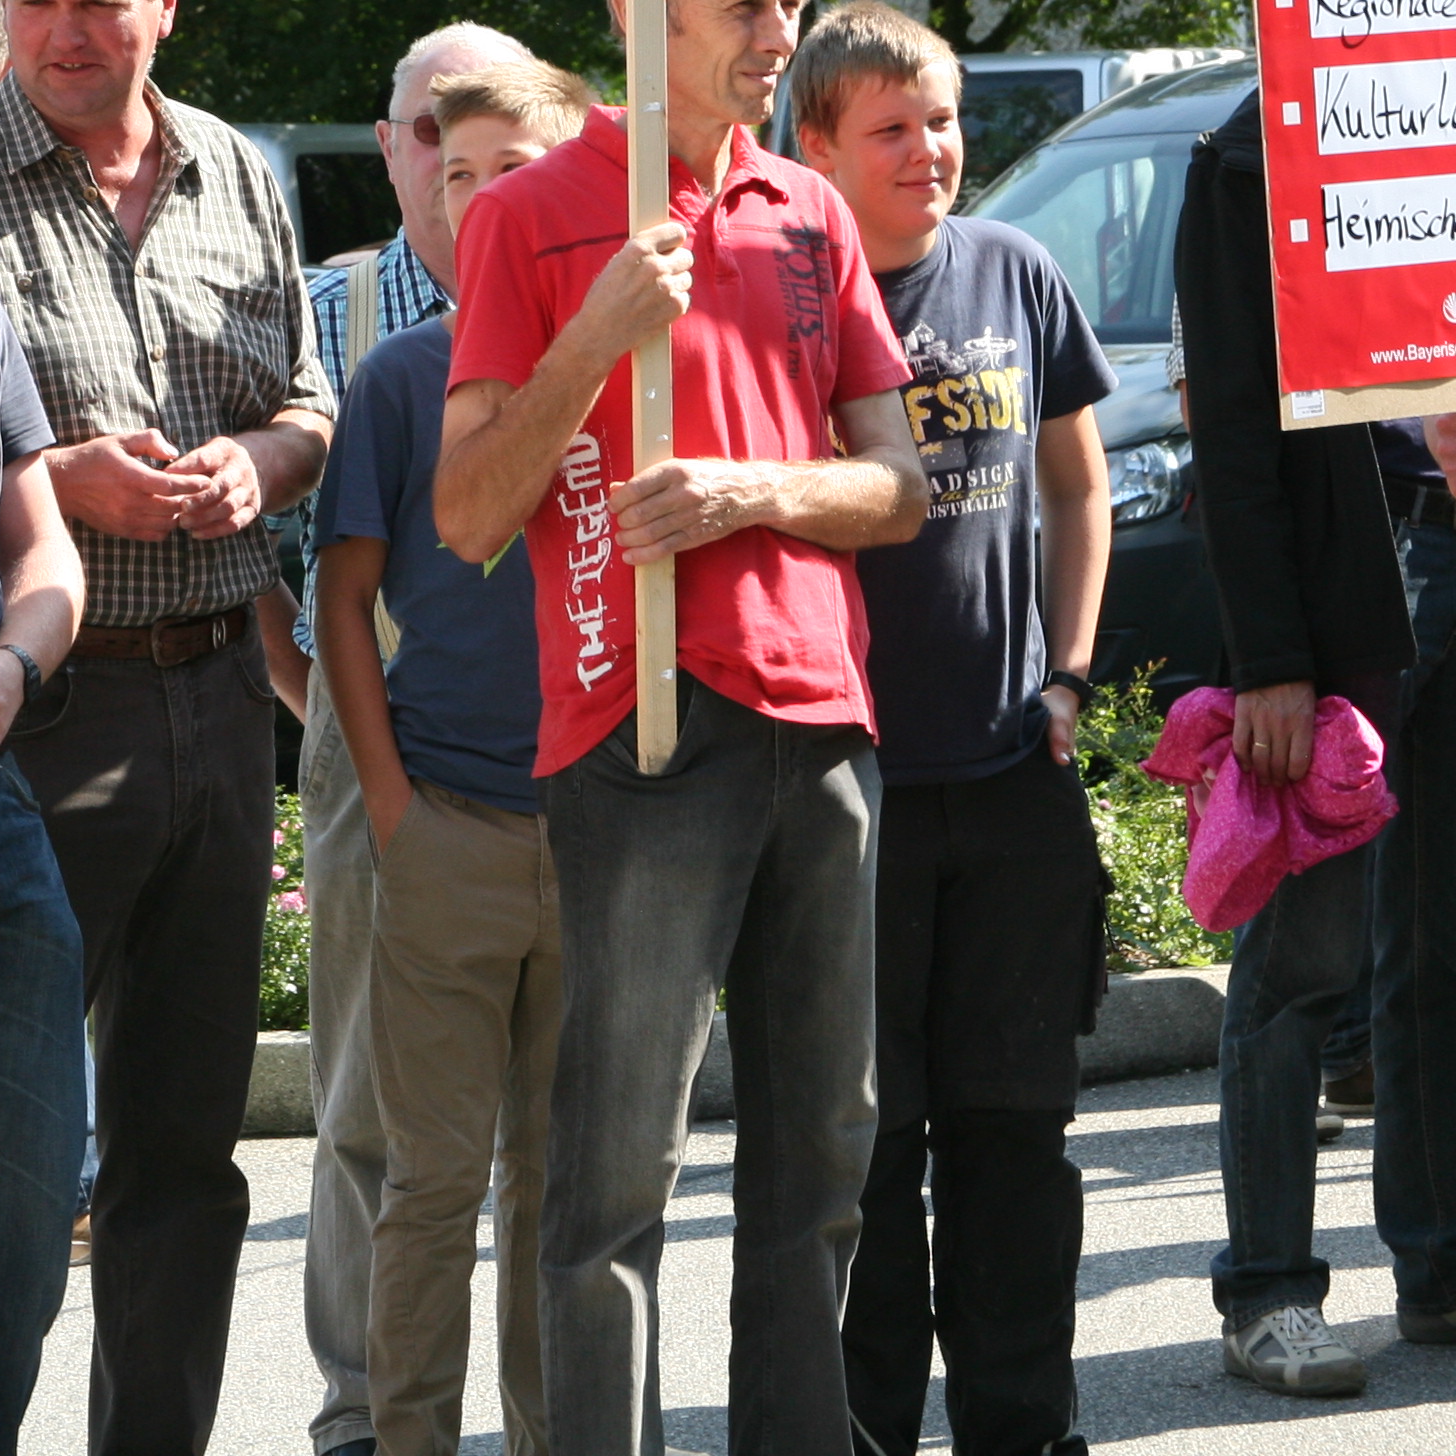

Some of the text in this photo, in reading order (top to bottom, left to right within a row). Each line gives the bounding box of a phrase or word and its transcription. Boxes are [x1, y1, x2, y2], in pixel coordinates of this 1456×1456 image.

[905, 366, 1028, 443] FSIDE
[930, 461, 1014, 494] ADSIGN
[926, 493, 1007, 519] USTRALIA
[564, 594, 613, 691] THE
